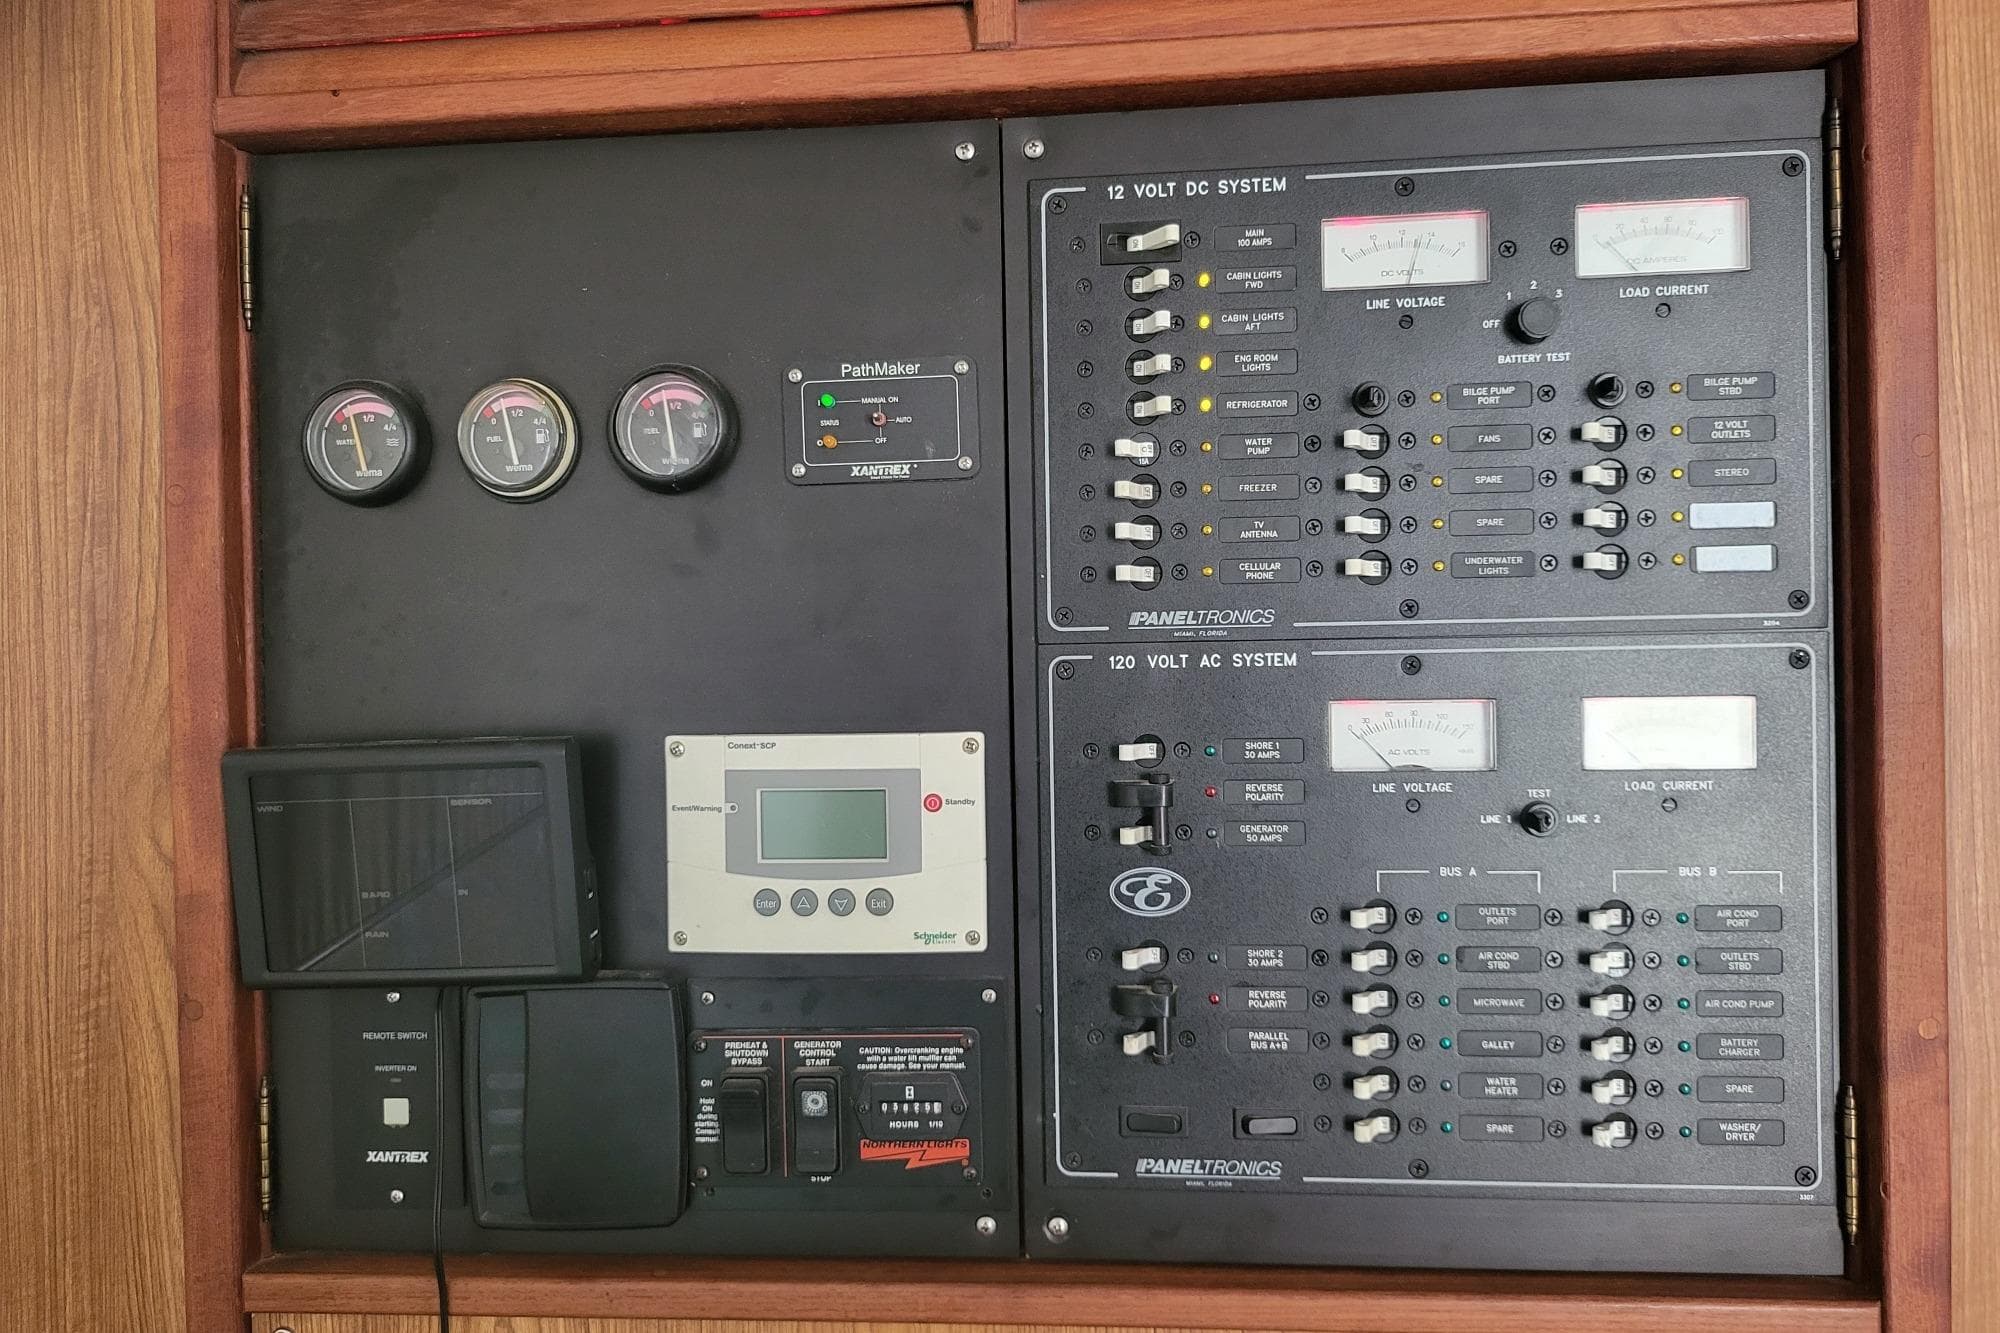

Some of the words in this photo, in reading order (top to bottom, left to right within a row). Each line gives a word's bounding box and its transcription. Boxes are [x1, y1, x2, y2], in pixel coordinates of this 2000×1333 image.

[1107, 186, 1124, 199] 12
[1134, 183, 1176, 198] VOLT
[1186, 182, 1209, 195] DC
[1218, 177, 1287, 194] SYSTEM
[1245, 229, 1264, 237] MAIN
[1238, 239, 1250, 247] 100
[1251, 237, 1272, 246] AMPS
[1227, 272, 1251, 280] CABIN
[1254, 271, 1282, 279] LIGHTS
[1245, 280, 1263, 289] FWD
[1531, 281, 1537, 289] 2
[1556, 289, 1563, 298] 3
[1619, 288, 1649, 298] LOAD
[1656, 285, 1709, 296] CURRENT
[1507, 292, 1511, 300] 1
[1366, 300, 1390, 310] LINE
[1396, 297, 1445, 308] VOLTAGE
[1253, 313, 1284, 321] LIGHTS
[1483, 320, 1500, 329] OFF
[1235, 355, 1251, 363] ENG
[1253, 354, 1278, 362] ROOM
[1498, 354, 1540, 363] BATTERY
[1547, 353, 1571, 361] TEST
[842, 362, 920, 377] PathMaker
[1242, 363, 1271, 371] LIGHTS
[1227, 400, 1288, 408] REFRIGERATOR
[1714, 421, 1723, 429] 12
[1711, 430, 1750, 438] OUTLETS
[1245, 438, 1272, 446] WATER
[1478, 435, 1501, 443] FANS
[1247, 447, 1270, 455] PUMP
[506, 464, 532, 472] wema
[850, 464, 911, 477] XANTREX
[1239, 484, 1277, 492] FREEZER
[1129, 609, 1275, 625] PANELTRONICS
[1109, 656, 1135, 669] 120
[1148, 654, 1188, 668] VOLT
[1200, 654, 1220, 667] AC
[1233, 653, 1296, 666] SYSTEM
[1246, 784, 1283, 792] REVERSE
[1373, 783, 1396, 792] LINE
[1403, 783, 1453, 792] VOLTAGE
[1625, 782, 1655, 791] LOAD
[1663, 781, 1714, 791] CURRENT
[1246, 793, 1284, 801] POLARITY
[451, 798, 492, 806] SENSOR
[945, 798, 976, 807] Standby
[257, 805, 283, 813] WIND
[672, 805, 722, 813] Event/Warning
[1481, 815, 1501, 823] LINE
[1567, 815, 1587, 823] LINE
[1594, 815, 1600, 823] 2
[1240, 825, 1288, 833] GENERATOR
[1247, 834, 1258, 842] 50
[1260, 834, 1282, 842] AMPS
[1440, 868, 1461, 877] BUS
[1469, 868, 1477, 876] A
[1679, 868, 1700, 876] BUS
[362, 891, 390, 899] BARO
[756, 899, 776, 908] Enter
[871, 899, 886, 908] Exit
[1479, 908, 1516, 916] OUTLETS
[1486, 917, 1508, 925] PORT
[366, 931, 389, 939] RAIN
[913, 931, 958, 945] Schneider
[1478, 952, 1493, 960] AIR
[1496, 952, 1519, 960] COND
[1721, 953, 1759, 961] OUTLETS
[1487, 961, 1510, 969] STBD
[1729, 962, 1752, 970] STBD
[1473, 999, 1525, 1008] MICROWAVE
[1705, 1000, 1719, 1008] AIR
[363, 1032, 395, 1040] REMOTE
[398, 1032, 427, 1040] SWITCH
[1249, 1032, 1289, 1040] PARALLEL
[1251, 1041, 1267, 1049] BUS
[1269, 1041, 1287, 1049] A+B
[1482, 1041, 1515, 1049] GALLEY
[1721, 1039, 1758, 1047] BATTERY
[1719, 1048, 1760, 1056] CHARGER
[1486, 1078, 1515, 1086] WATER
[1485, 1087, 1518, 1095] HEATER
[1719, 1123, 1761, 1132] WASHER/
[1726, 1132, 1755, 1141] DRYER
[366, 1151, 429, 1163] XANTREX
[1136, 1158, 1282, 1175] PANELTRONICS
